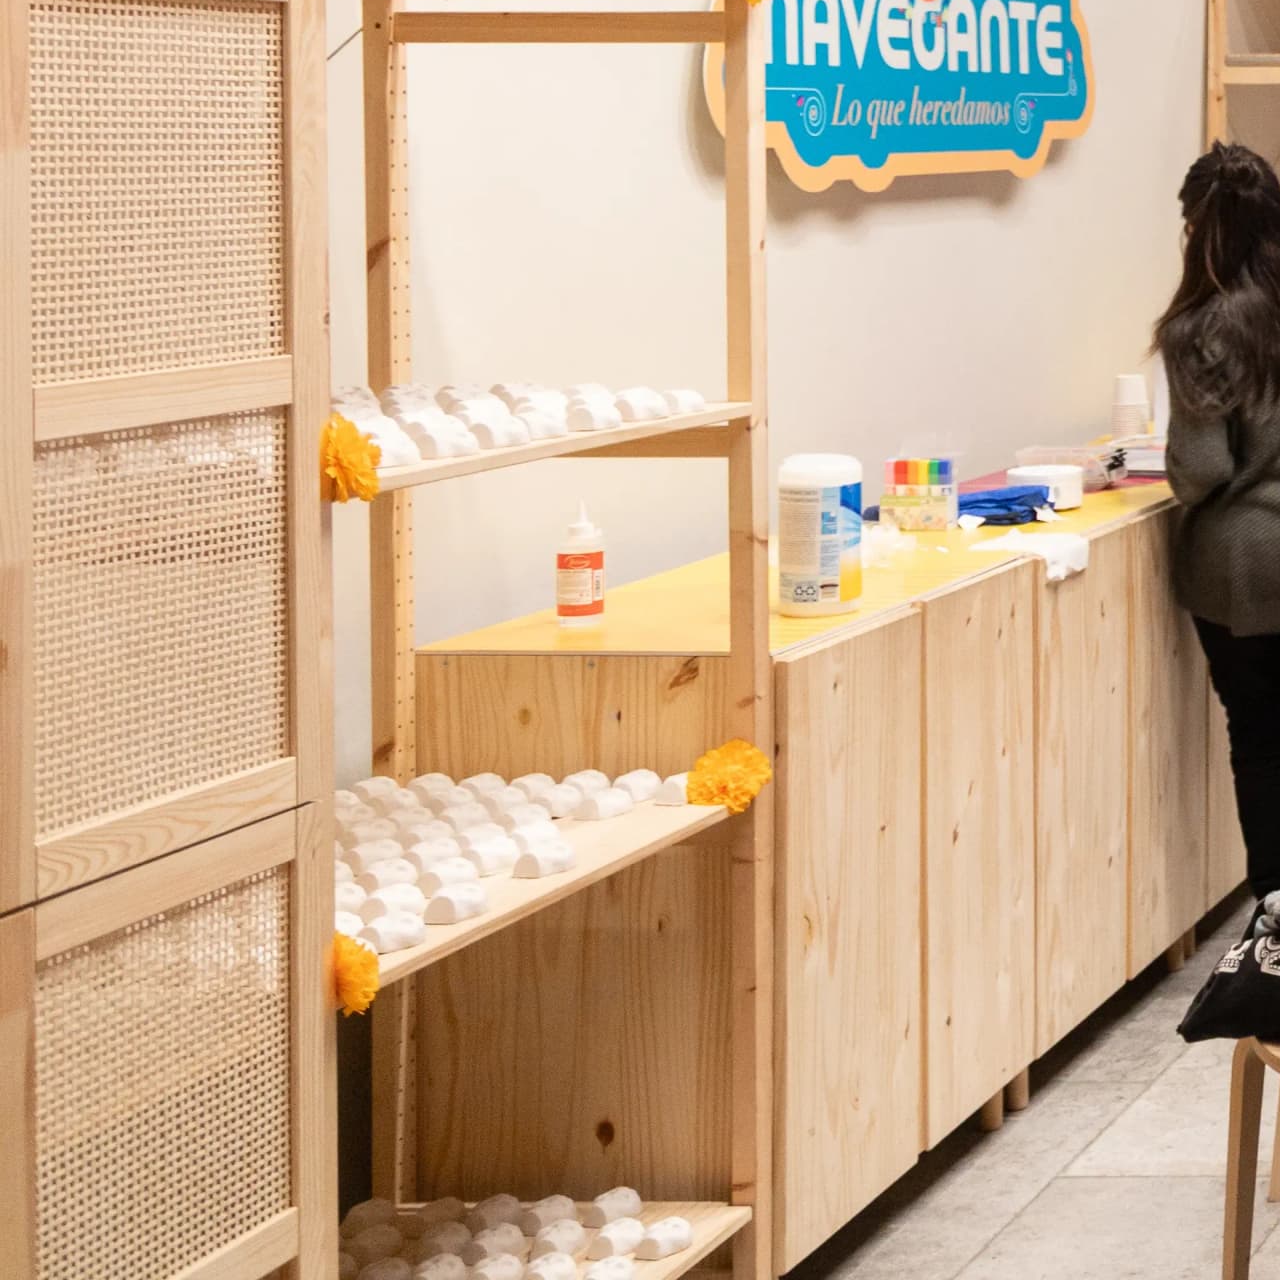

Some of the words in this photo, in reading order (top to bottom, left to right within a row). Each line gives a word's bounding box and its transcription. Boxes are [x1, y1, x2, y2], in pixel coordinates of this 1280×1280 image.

[831, 83, 861, 126] Lo
[867, 98, 905, 140] que
[908, 85, 1011, 127] heredamos
